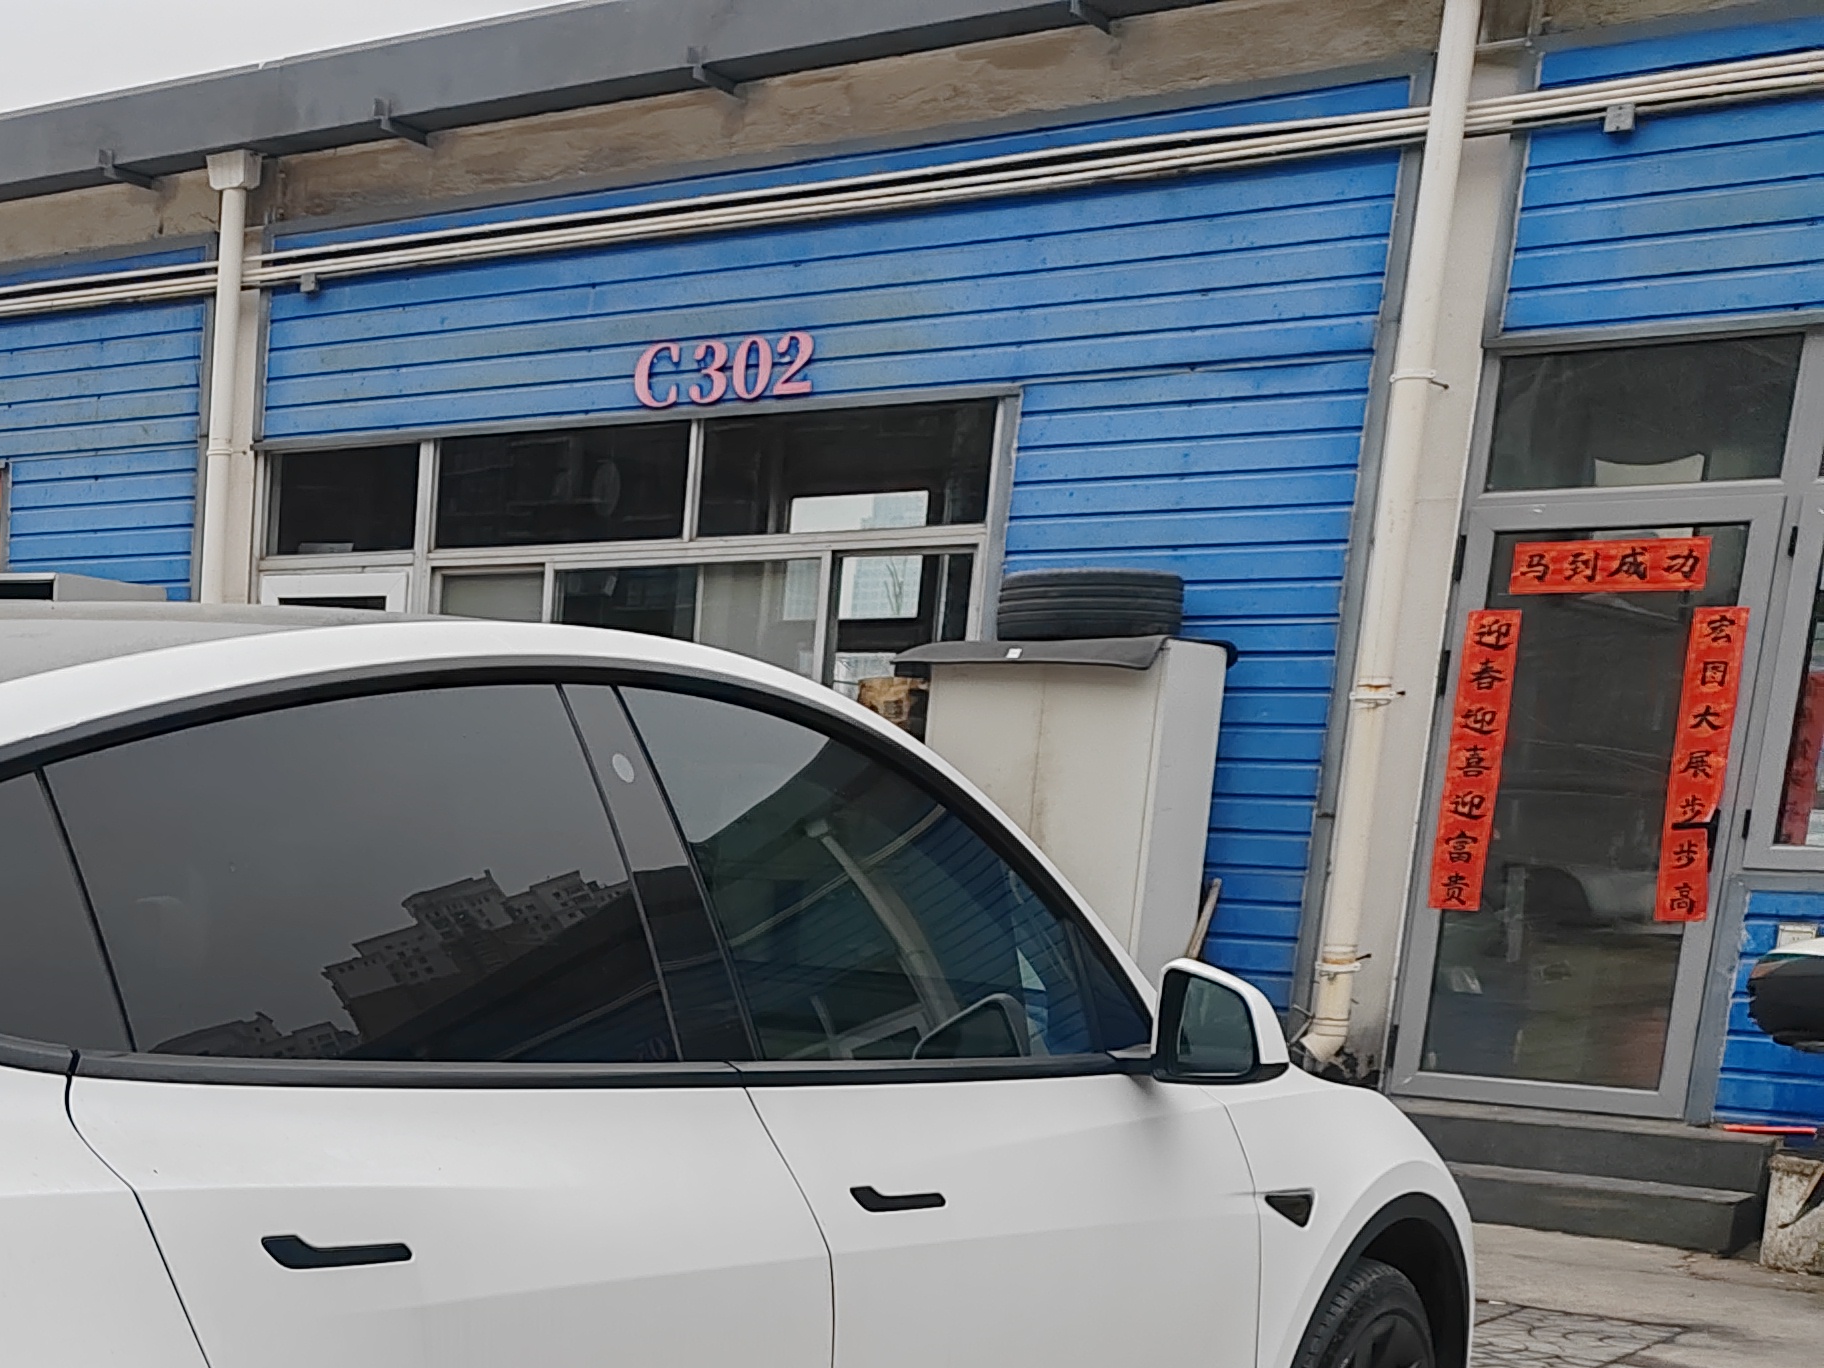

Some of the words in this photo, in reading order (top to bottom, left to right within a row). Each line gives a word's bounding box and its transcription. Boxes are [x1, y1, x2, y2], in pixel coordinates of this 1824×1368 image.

[634, 331, 815, 408] C302
[1520, 546, 1700, 582] 马到成功
[1441, 618, 1514, 905] 迎春迎喜迎富贵
